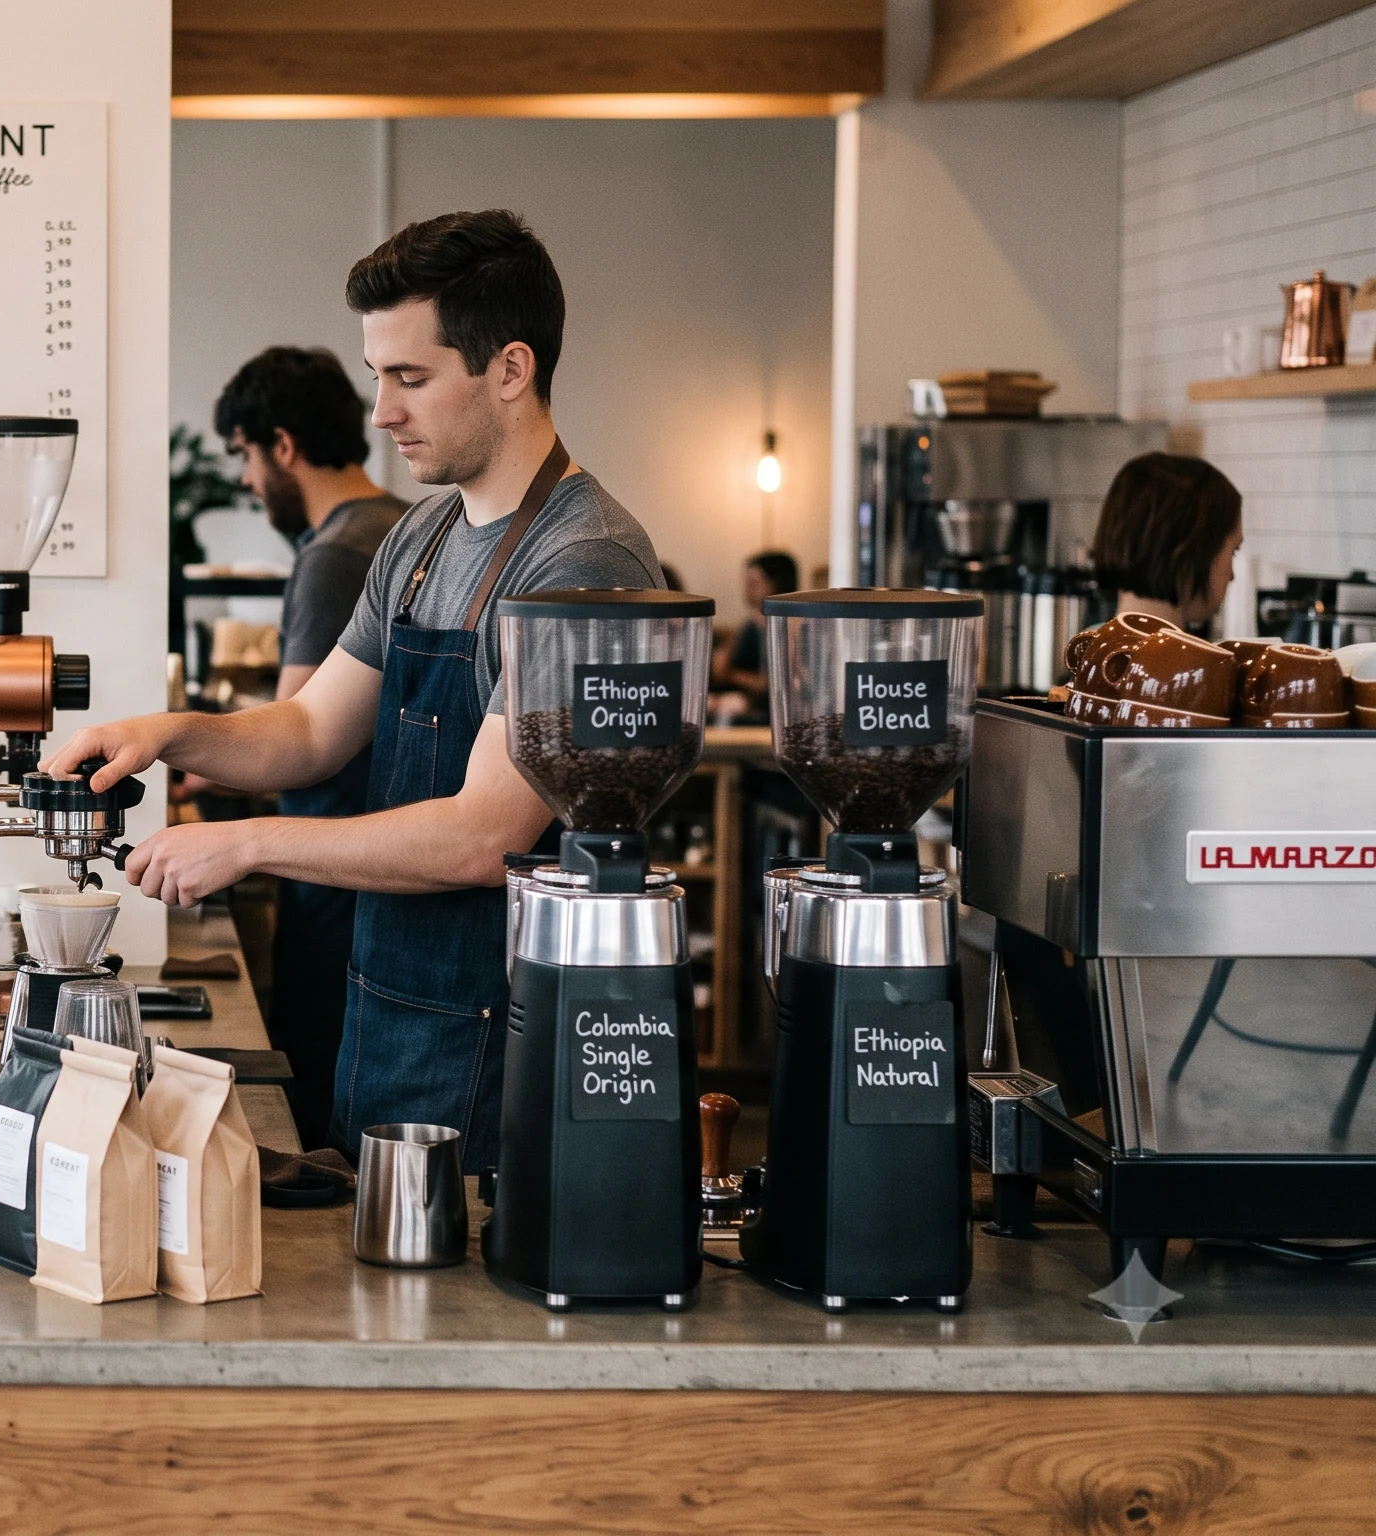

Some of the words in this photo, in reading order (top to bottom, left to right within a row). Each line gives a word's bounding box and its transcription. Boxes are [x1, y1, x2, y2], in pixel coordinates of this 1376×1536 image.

[584, 676, 670, 706] Ethiopia
[857, 674, 928, 699] House
[591, 705, 657, 738] Origin
[858, 704, 931, 731] Blend
[1200, 846, 1233, 869] LA
[575, 1010, 675, 1037] Colombia
[854, 1027, 947, 1060] Ethiopia
[582, 1041, 653, 1075] Single
[856, 1060, 940, 1087] Natural
[583, 1071, 656, 1105] Origin
